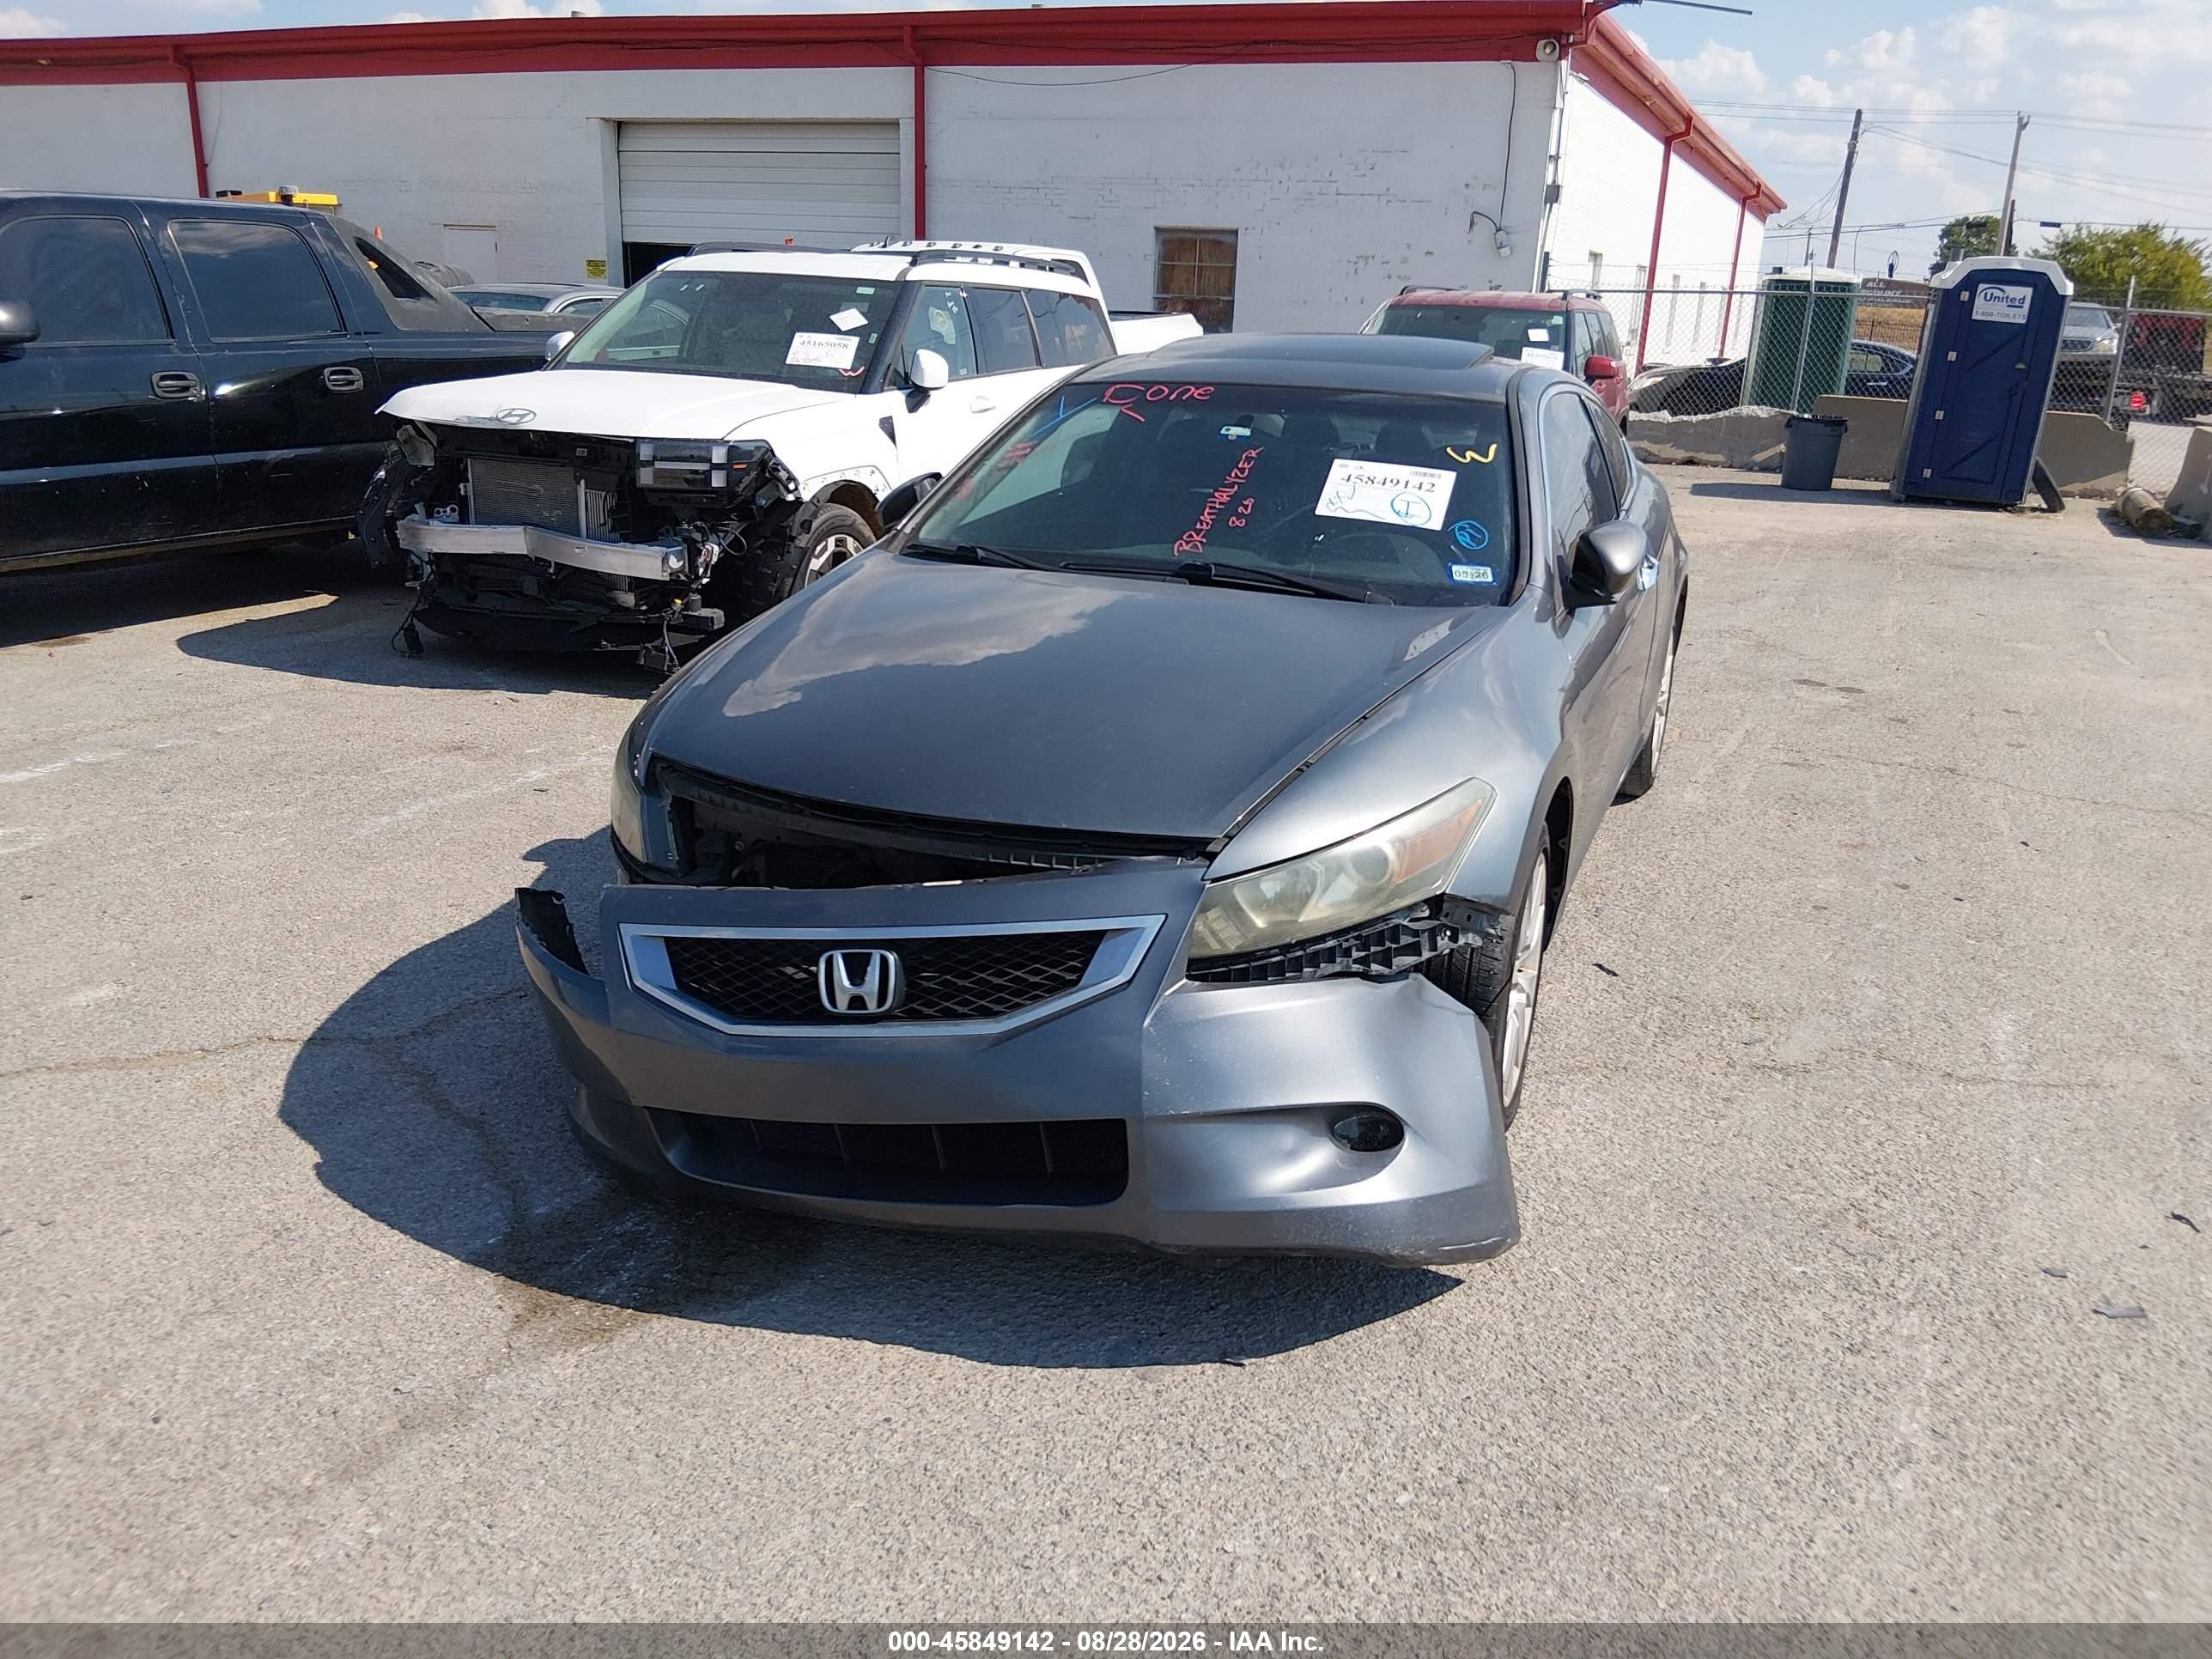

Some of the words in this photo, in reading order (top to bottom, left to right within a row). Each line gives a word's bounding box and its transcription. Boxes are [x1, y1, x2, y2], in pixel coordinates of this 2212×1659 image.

[1984, 292, 2027, 305] United
[1340, 473, 1437, 494] 45849142
[1173, 447, 1265, 556] BREATHALYZER
